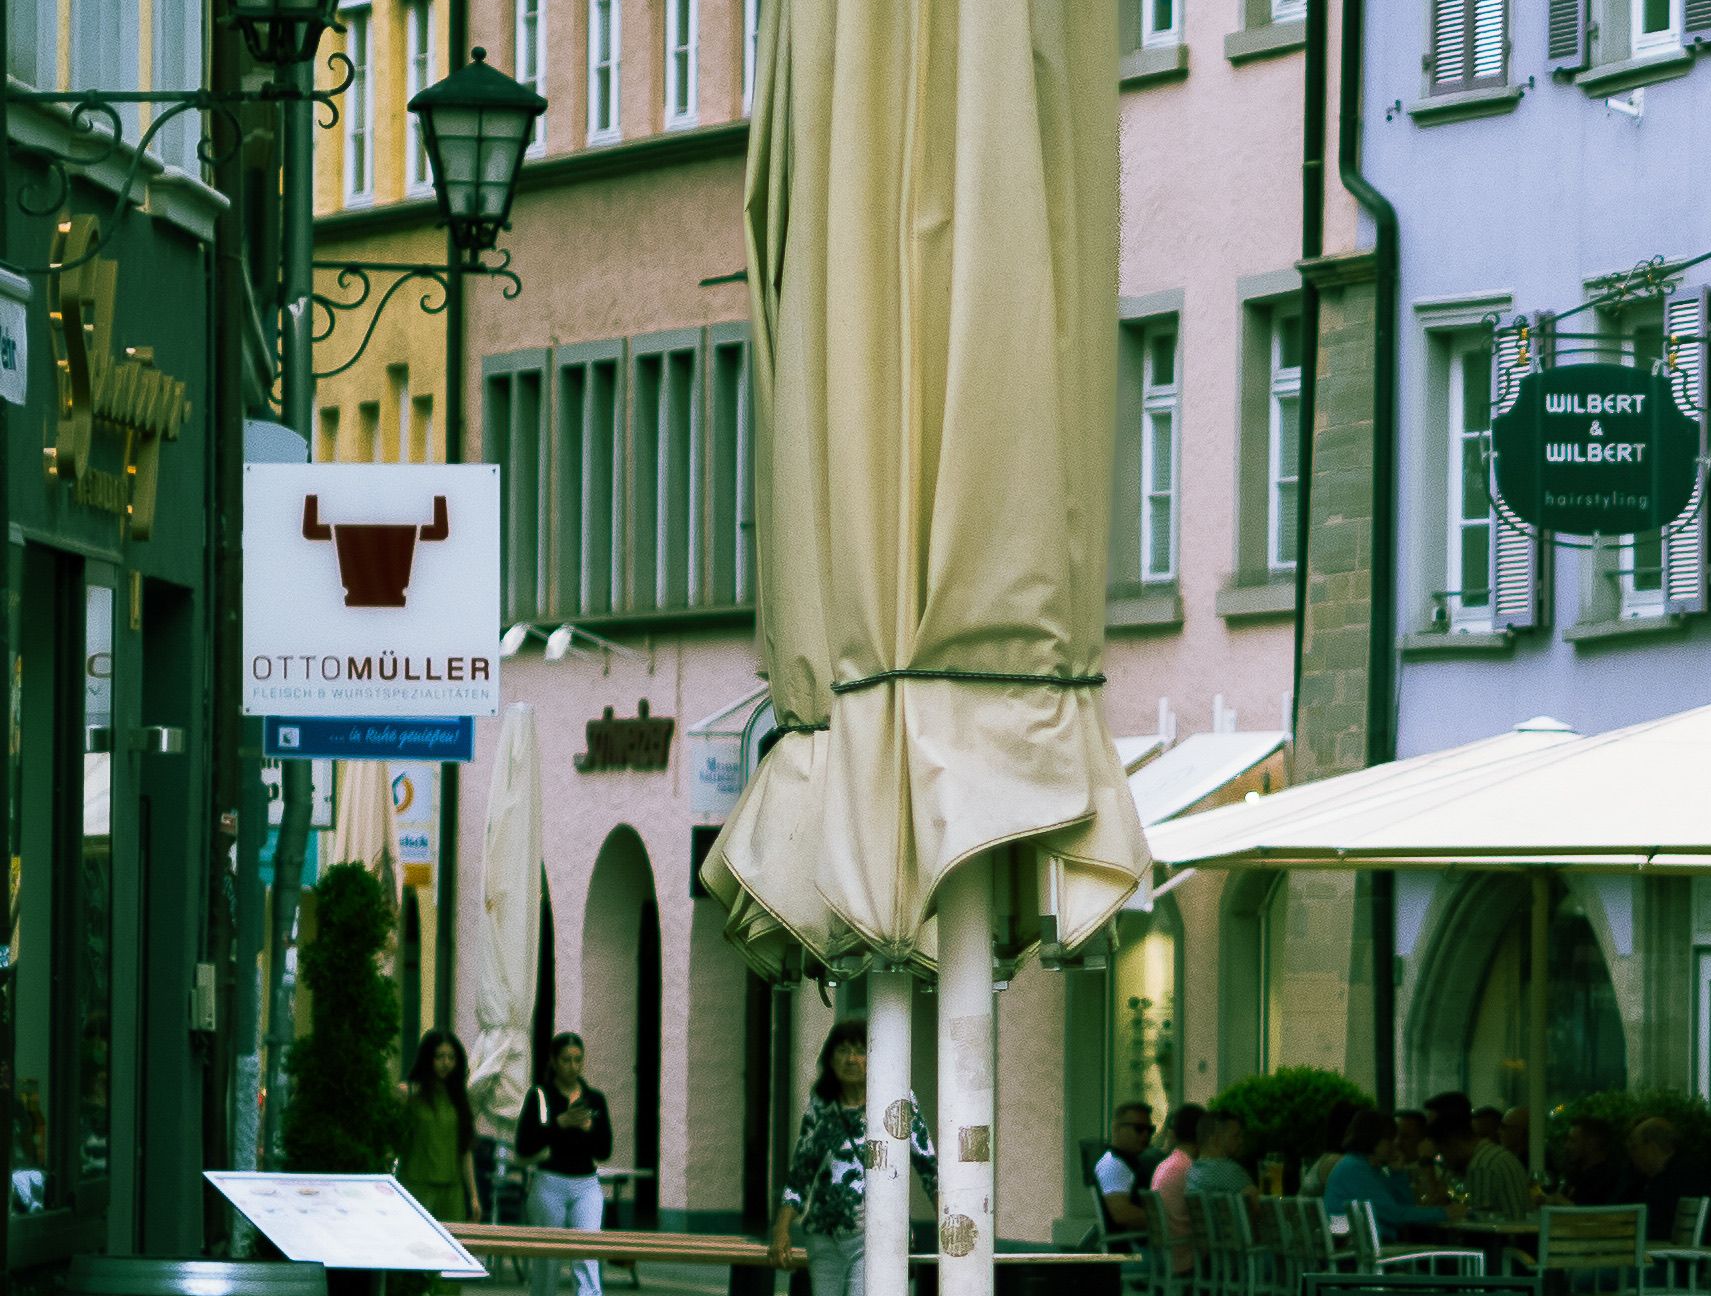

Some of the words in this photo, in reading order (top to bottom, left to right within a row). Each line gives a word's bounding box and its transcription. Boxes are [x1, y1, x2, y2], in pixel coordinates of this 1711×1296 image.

[1545, 393, 1646, 414] WILBERT
[1589, 420, 1604, 436] &
[1546, 443, 1646, 462] WILBERT
[1544, 490, 1648, 510] hairstyling
[253, 687, 312, 700] FLEISCH
